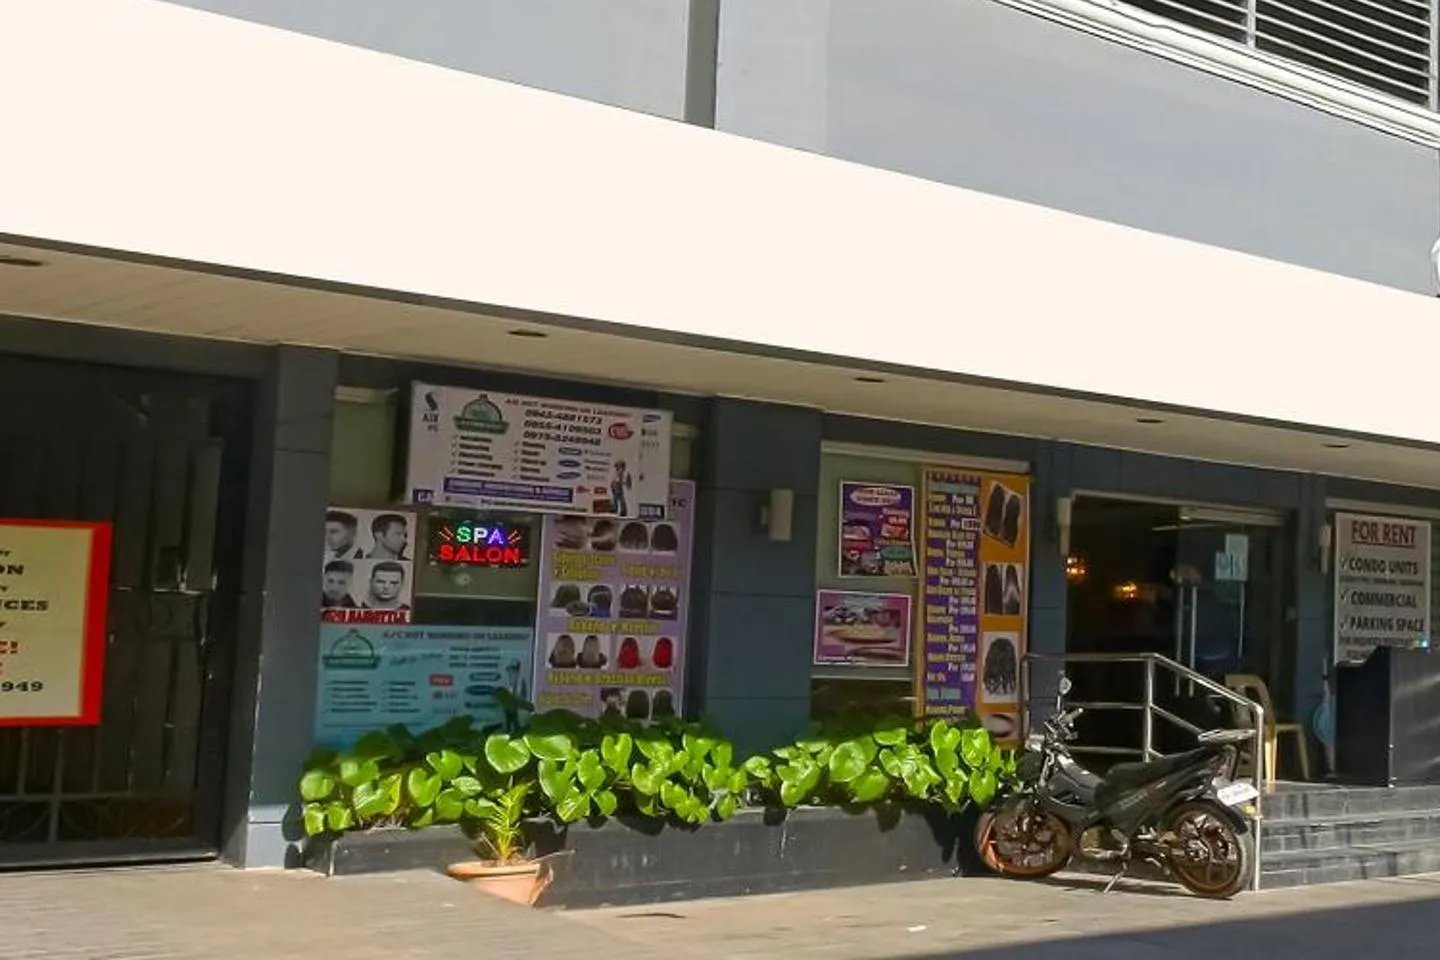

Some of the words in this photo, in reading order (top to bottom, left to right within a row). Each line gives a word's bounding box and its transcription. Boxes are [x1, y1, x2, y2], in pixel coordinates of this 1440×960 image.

[456, 526, 504, 544] SPA
[1351, 520, 1378, 541] FOR
[1383, 523, 1416, 544] RENT
[439, 543, 521, 564] SALON
[0, 564, 24, 576] N
[1349, 557, 1386, 574] CONDO
[1389, 560, 1419, 576] UNITS
[1350, 590, 1417, 608] COMMERCIAL
[1350, 616, 1394, 632] PARKING
[1396, 617, 1425, 633] SPACE
